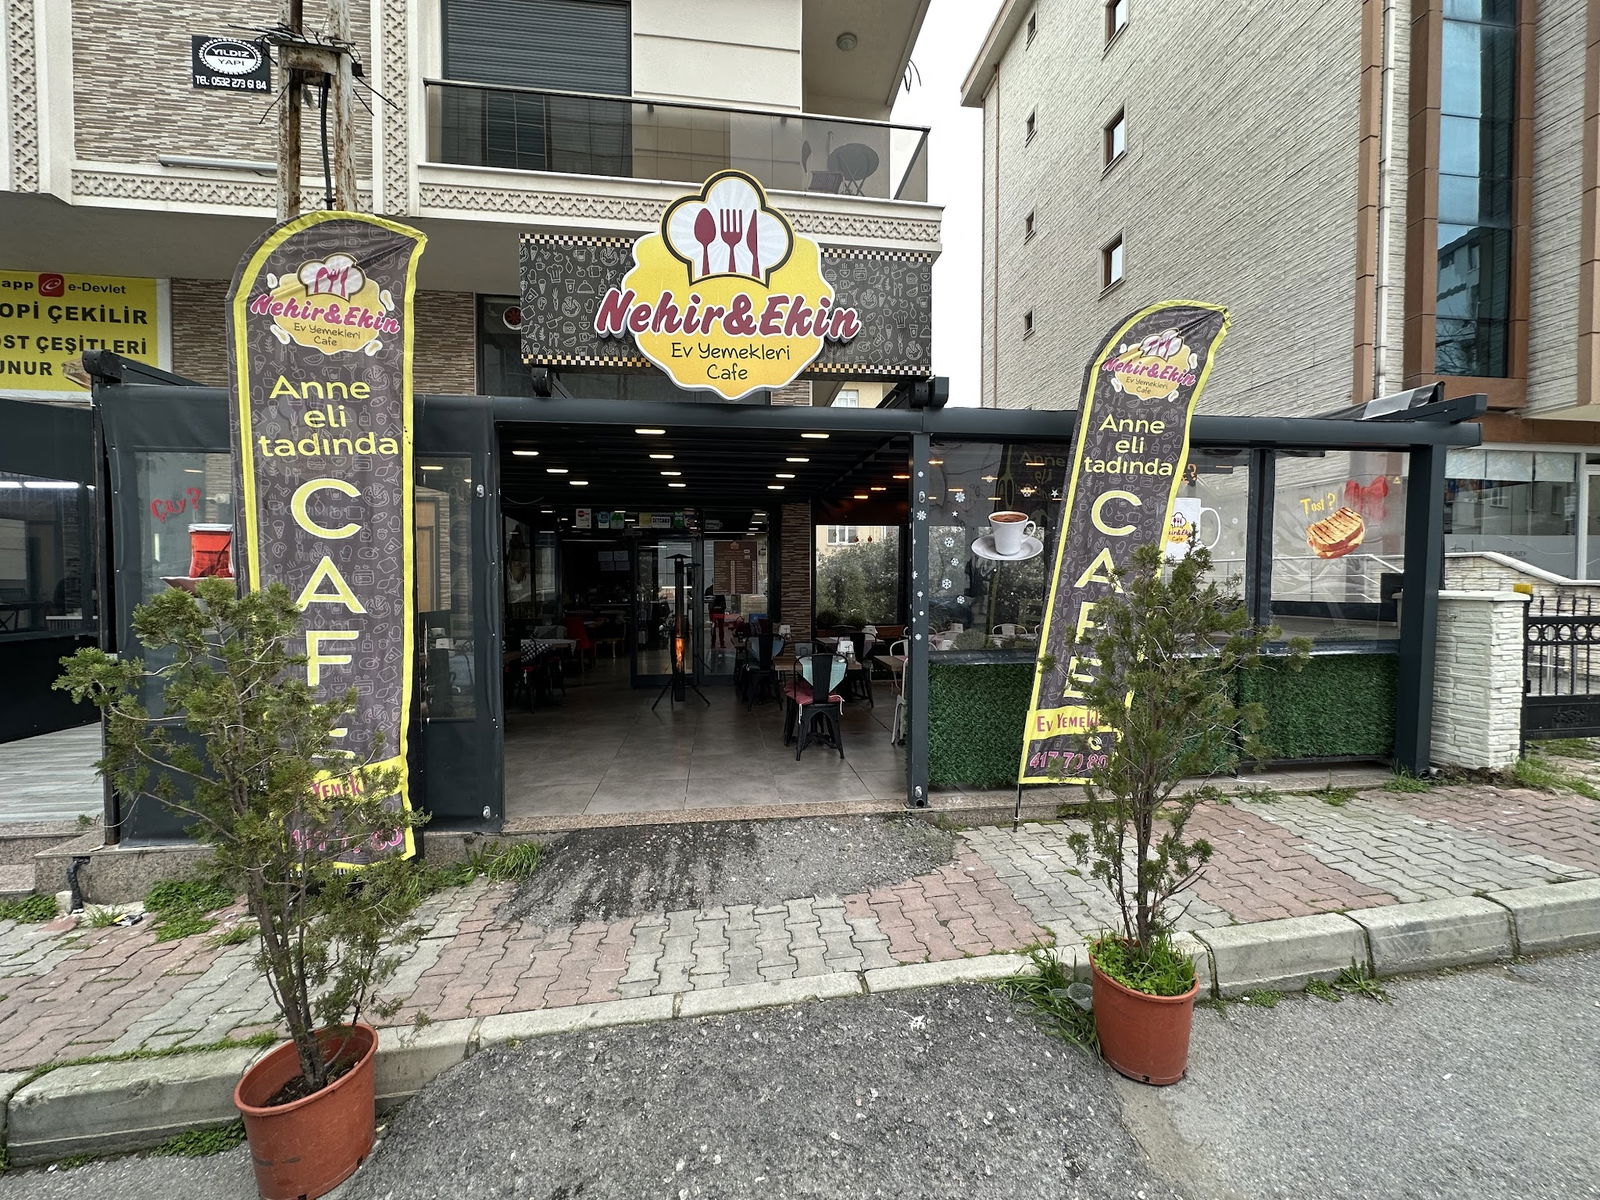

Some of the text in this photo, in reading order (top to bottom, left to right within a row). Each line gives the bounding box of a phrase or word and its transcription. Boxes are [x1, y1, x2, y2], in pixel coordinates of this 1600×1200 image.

[211, 48, 250, 58] YILDIZ
[218, 58, 245, 67] YAPI
[211, 76, 230, 87] 0532
[231, 78, 246, 88] 273
[247, 79, 254, 89] 61
[256, 80, 267, 90] 84
[68, 282, 127, 294] e-Devlet
[48, 305, 148, 324] ÇEKİLİR
[251, 294, 400, 334] Nehir&Ekin
[596, 289, 861, 338] Nehir&Ekin
[294, 322, 361, 339] Ev Yemekleri
[0, 335, 29, 350] ST
[313, 336, 338, 346] Cafe
[671, 342, 790, 360] Ev Yemekleri
[706, 365, 748, 381] Cafe
[1102, 358, 1196, 386] Nehir&Ekin
[269, 375, 371, 399] Anne
[303, 404, 347, 428] eli
[1099, 414, 1166, 434] Anne
[258, 431, 399, 457] tadında
[1115, 436, 1145, 454] eli
[1083, 457, 1173, 476] tadında
